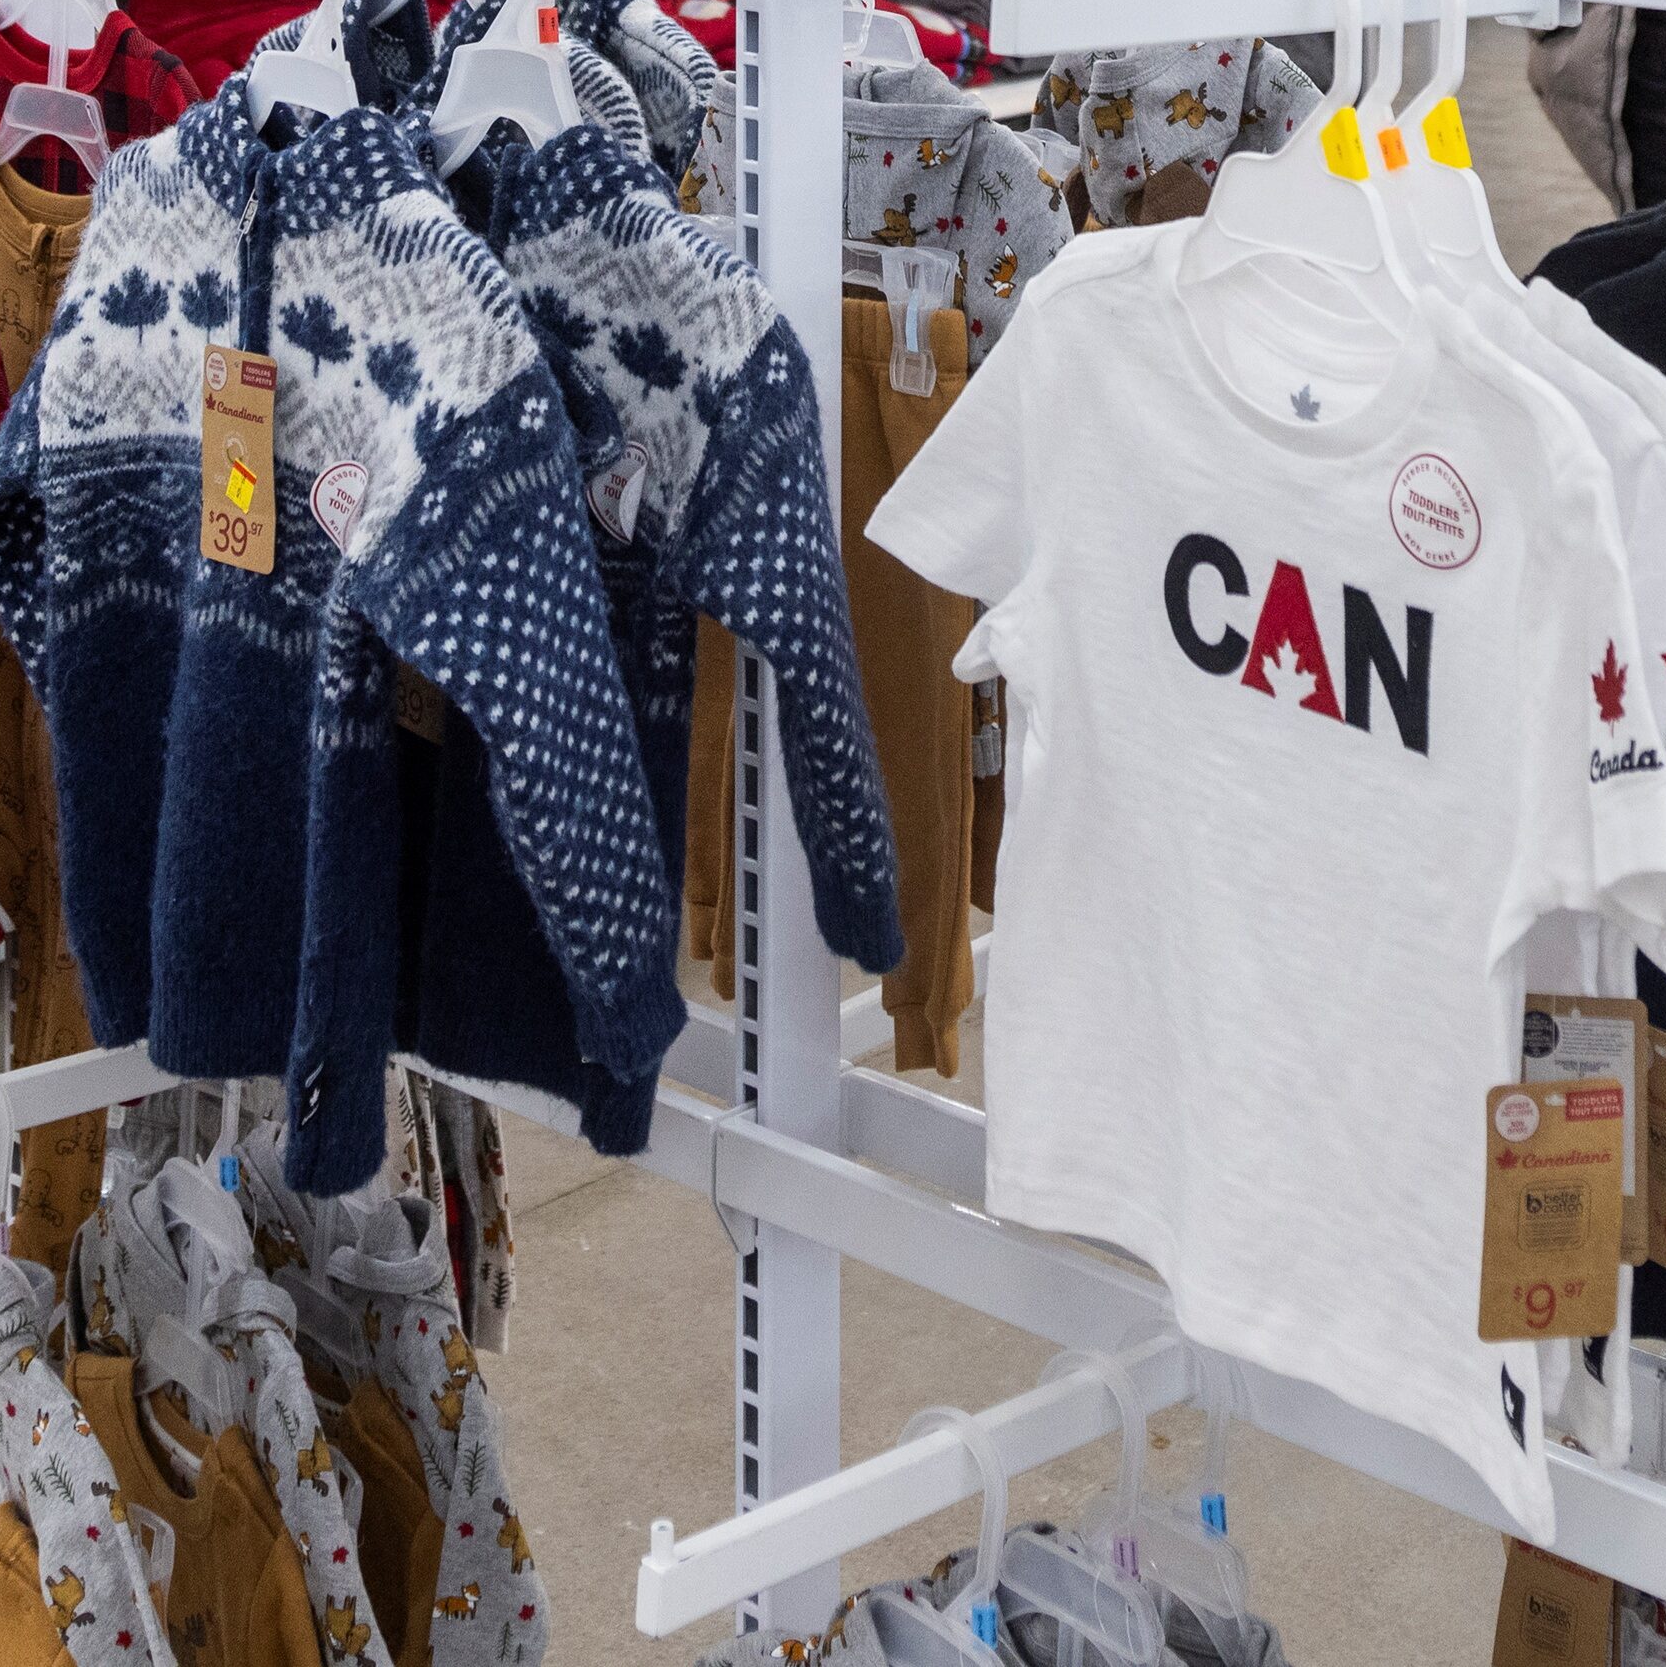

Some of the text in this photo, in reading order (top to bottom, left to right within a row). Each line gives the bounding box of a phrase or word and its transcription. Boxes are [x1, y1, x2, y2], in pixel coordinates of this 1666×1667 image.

[216, 401, 265, 424] Canadiana
[1401, 503, 1466, 540] TOUT-PETITS
[1408, 489, 1461, 523] TODDLERS
[1164, 532, 1434, 759] CAN
[1522, 1150, 1612, 1168] Canadiana
